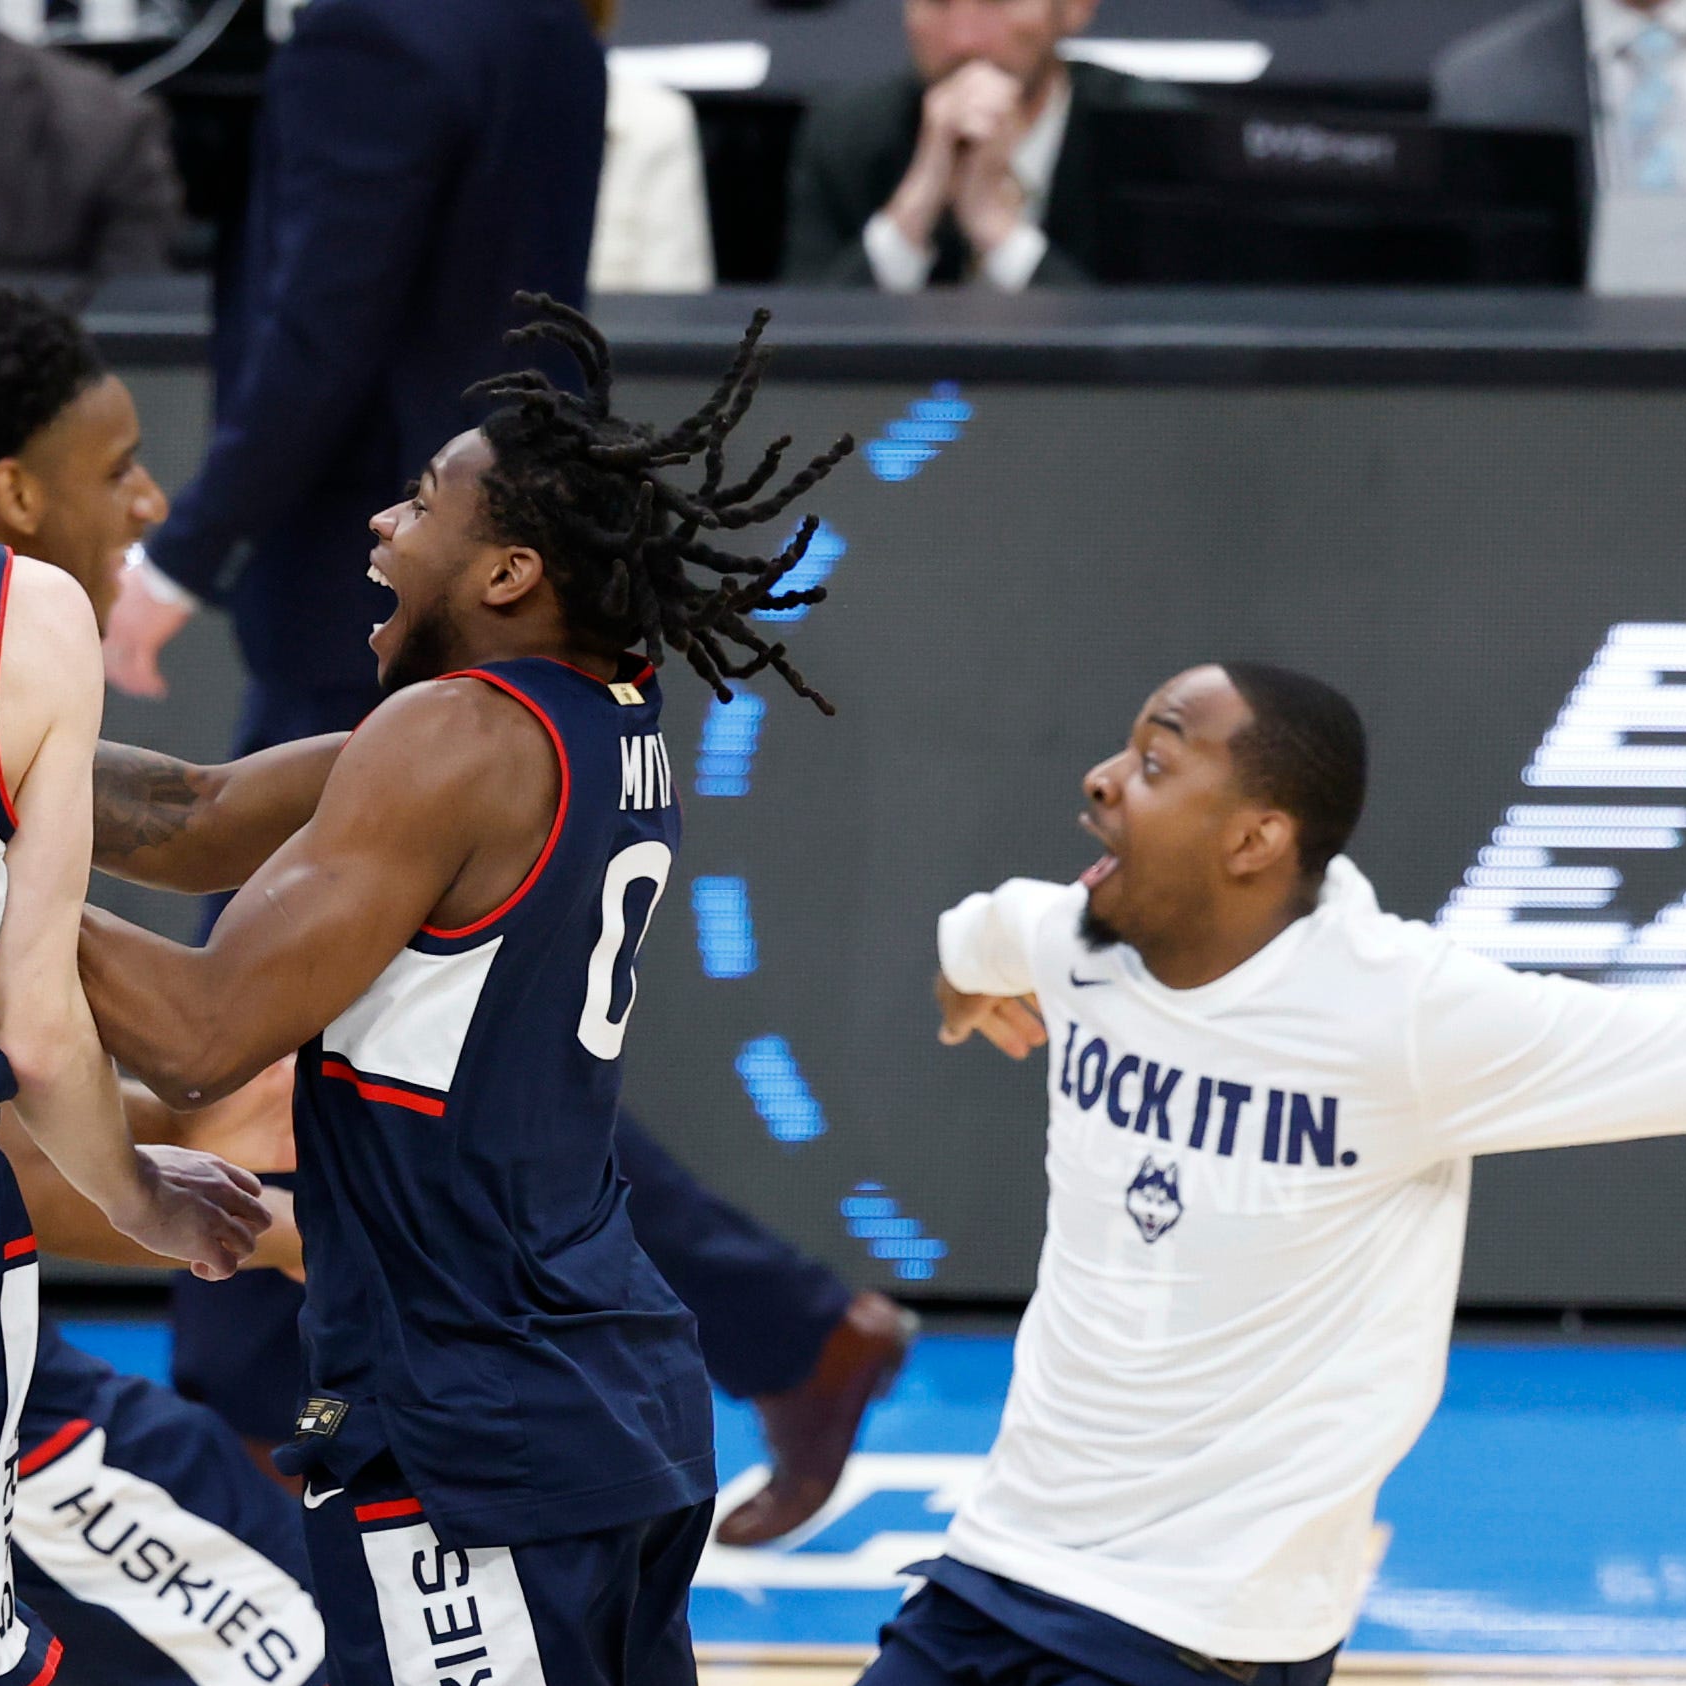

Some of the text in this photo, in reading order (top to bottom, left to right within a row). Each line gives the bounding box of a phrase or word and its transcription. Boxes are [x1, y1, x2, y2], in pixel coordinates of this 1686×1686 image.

[576, 840, 672, 1061] 0
[1060, 1022, 1358, 1167] LOCK IT IN.
